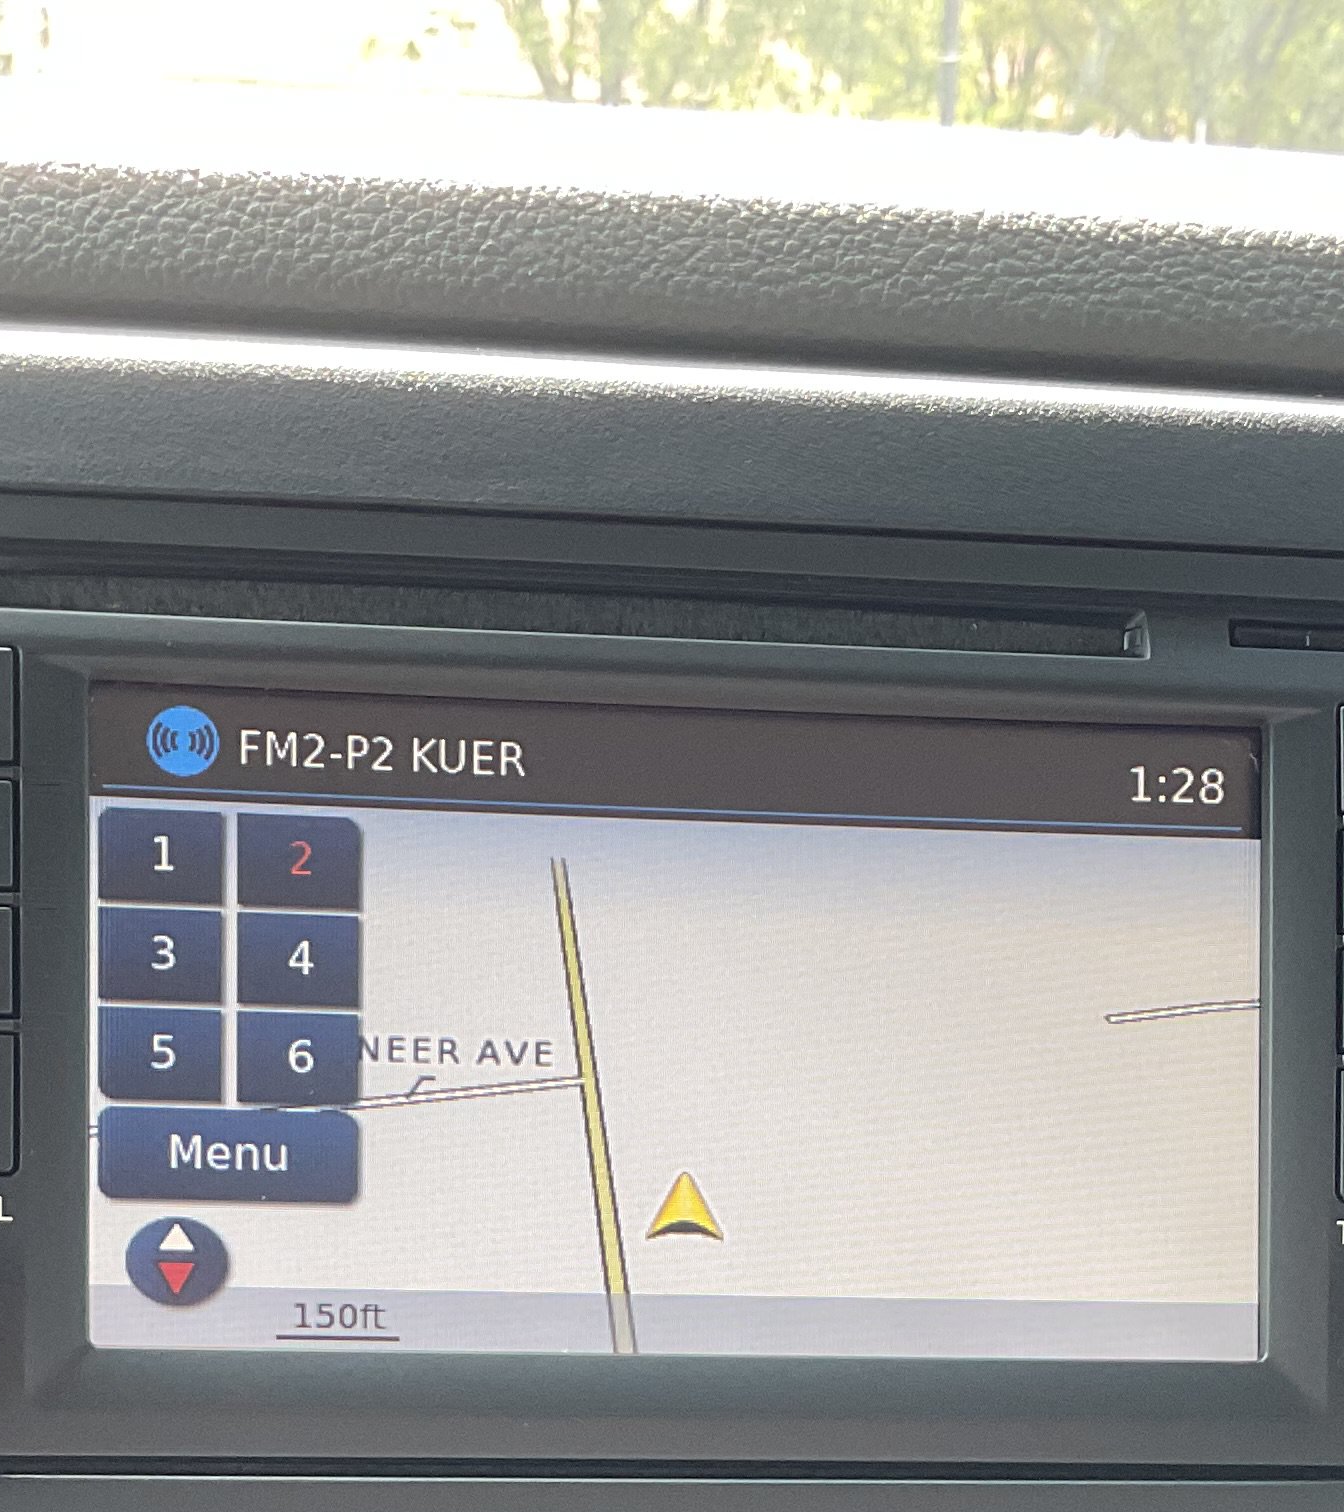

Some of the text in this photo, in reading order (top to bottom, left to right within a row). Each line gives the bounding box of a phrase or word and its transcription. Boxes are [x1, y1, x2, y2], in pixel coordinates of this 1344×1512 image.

[239, 729, 526, 777] FM2-P2 KUER
[1129, 765, 1226, 804] 1:28
[153, 834, 175, 871] 1
[289, 840, 312, 876] 2
[151, 935, 176, 970] 3
[288, 940, 314, 975] 4
[151, 1034, 175, 1069] 5
[287, 1039, 315, 1074] 6
[358, 1035, 554, 1067] NEER AVE
[169, 1134, 289, 1171] Menu
[294, 1303, 387, 1330] 150ft
